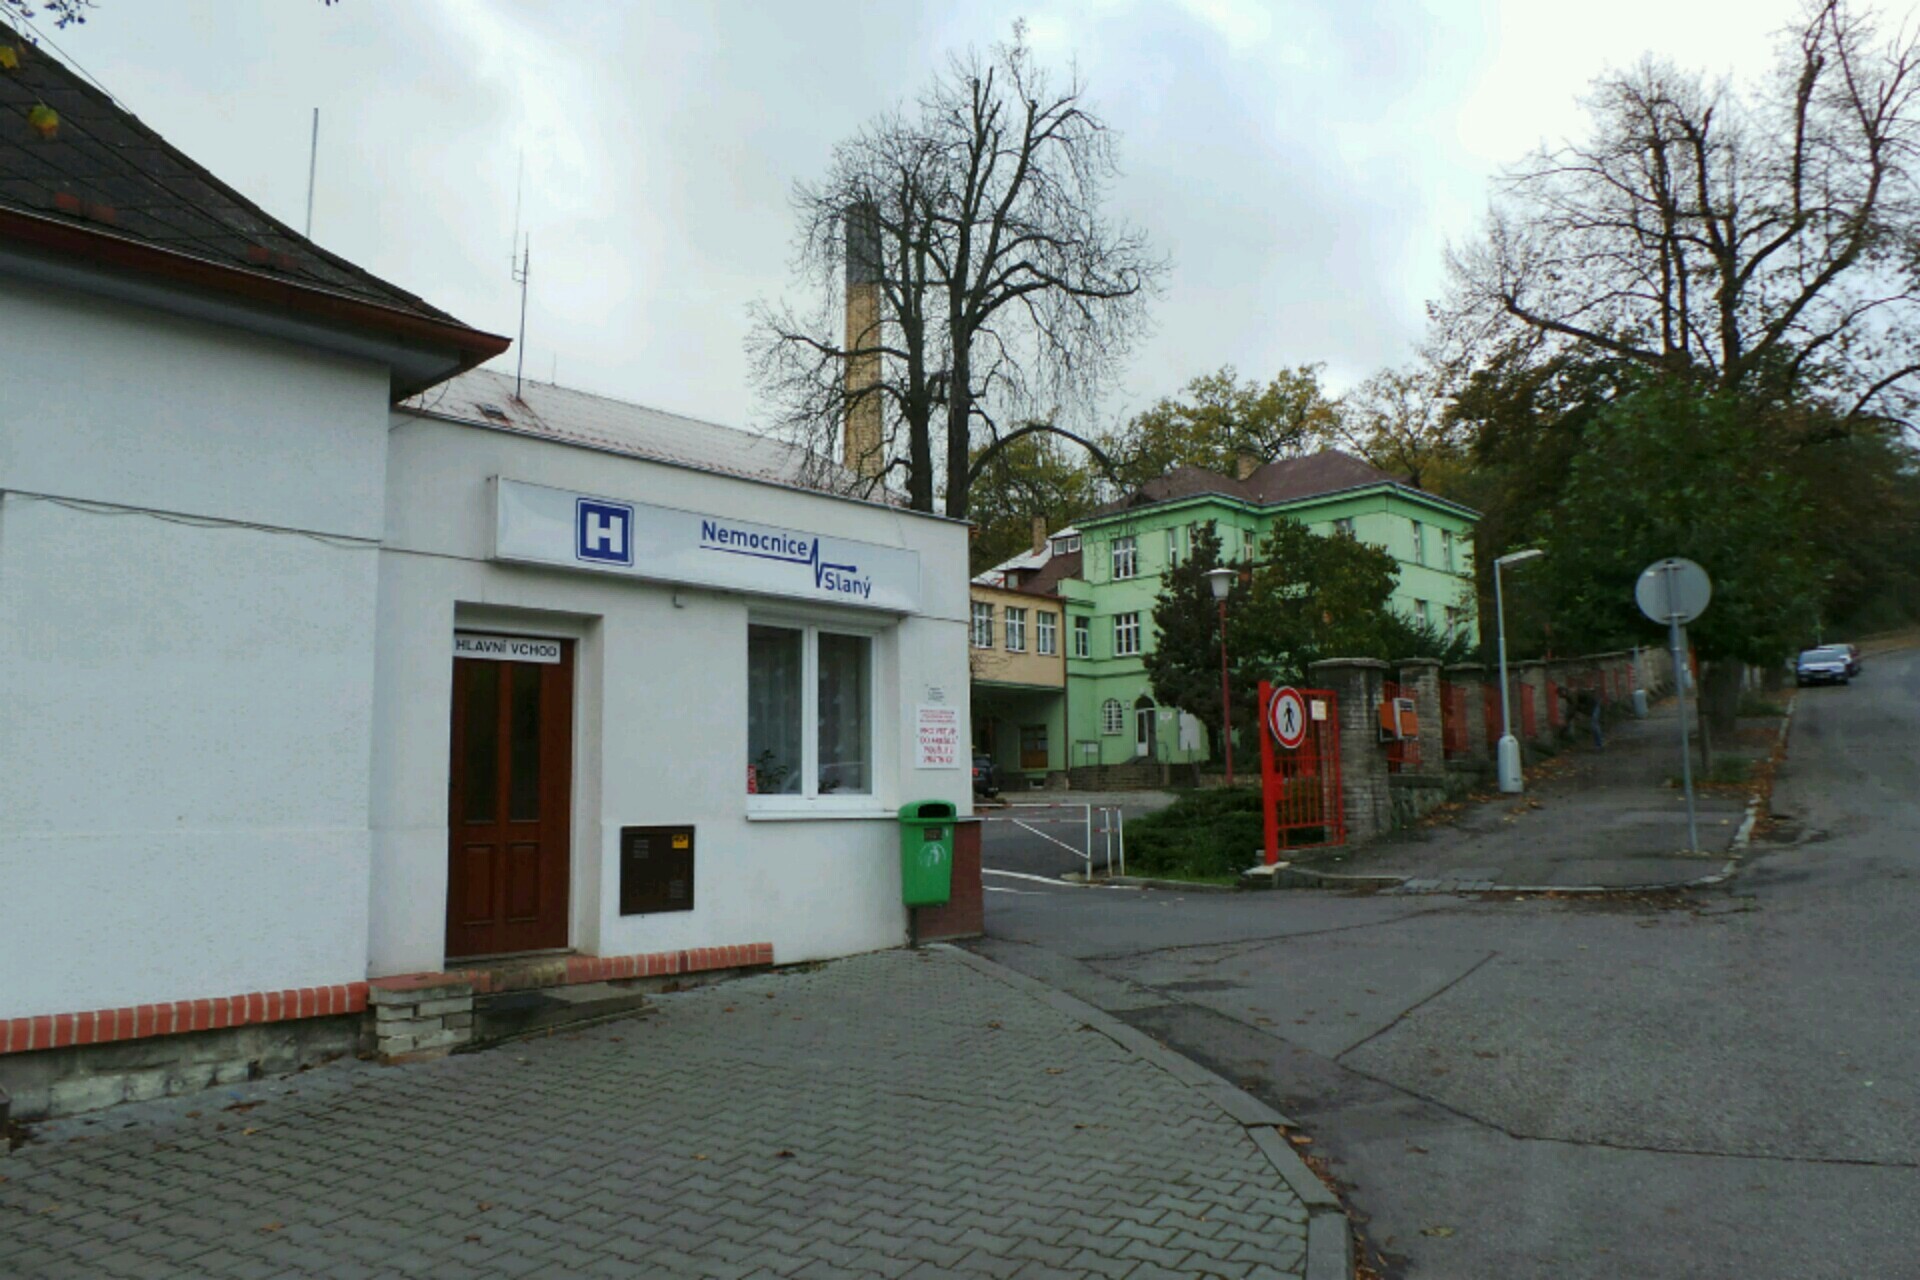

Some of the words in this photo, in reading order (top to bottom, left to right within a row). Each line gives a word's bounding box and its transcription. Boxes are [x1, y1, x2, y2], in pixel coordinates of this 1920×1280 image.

[586, 511, 623, 554] H
[702, 519, 808, 557] Nemocnice
[825, 571, 872, 599] Slaný
[455, 639, 507, 654] HLAVNÍ
[511, 643, 557, 657] VCHOD
